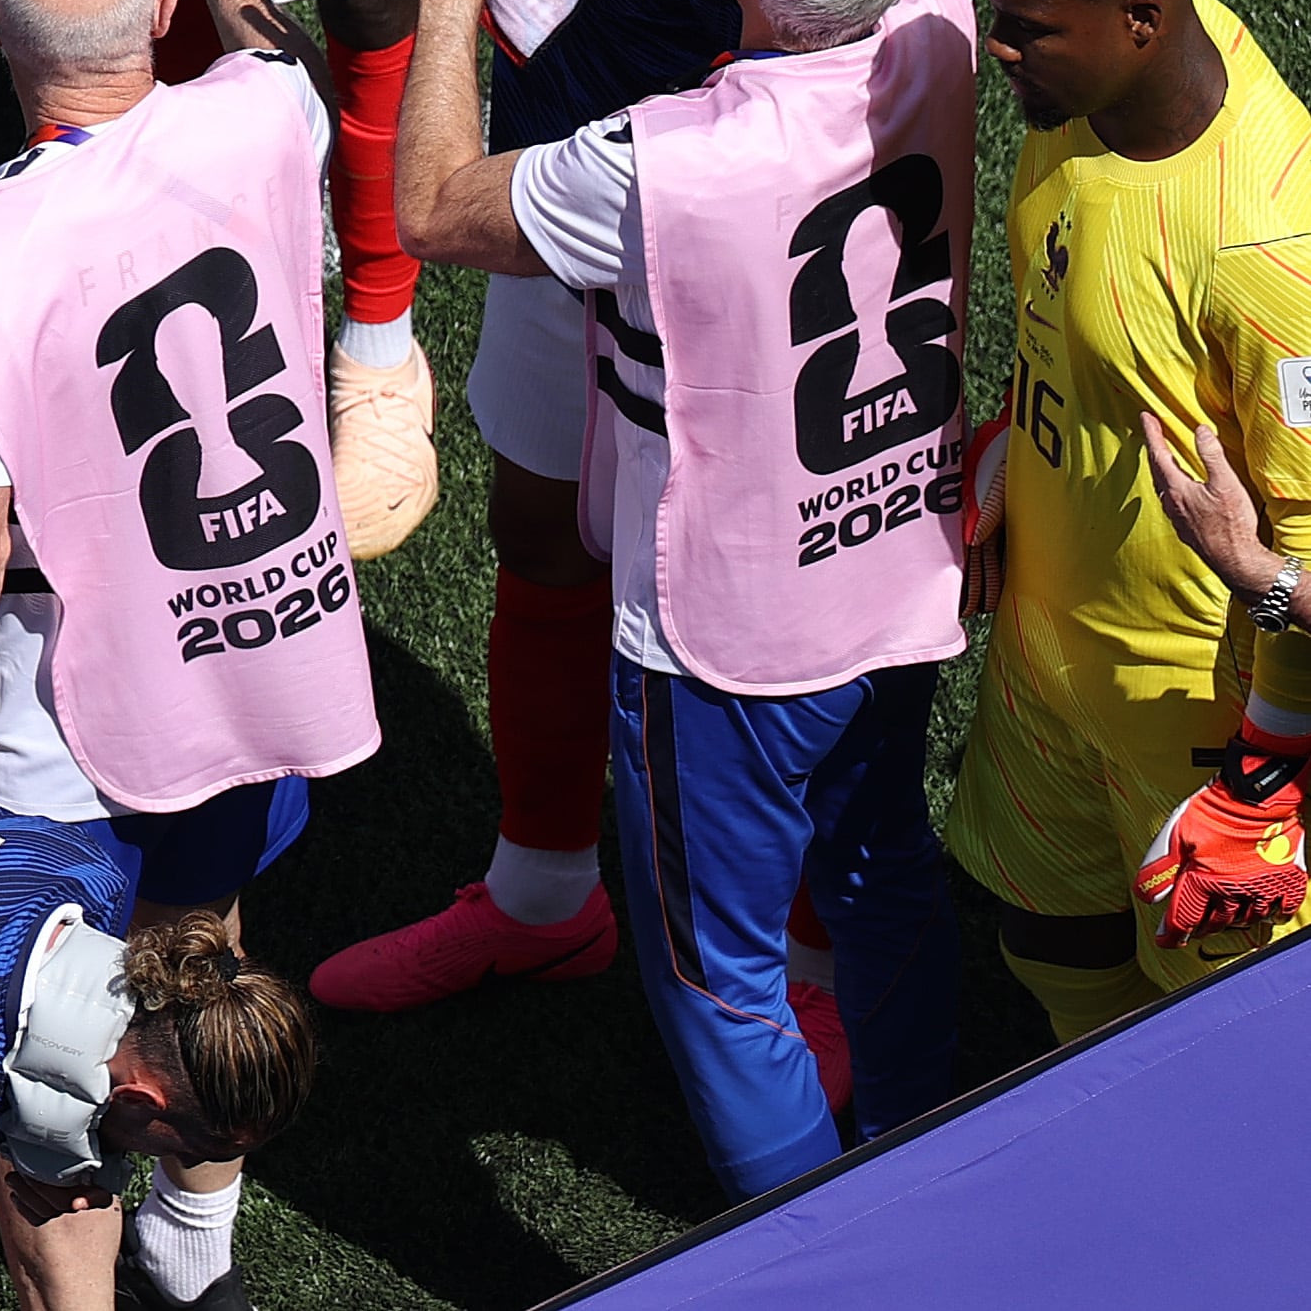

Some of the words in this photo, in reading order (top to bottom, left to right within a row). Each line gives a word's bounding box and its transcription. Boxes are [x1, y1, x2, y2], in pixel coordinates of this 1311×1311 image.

[843, 388, 919, 443] FIFA
[1016, 349, 1064, 469] 16
[198, 488, 288, 543] FIFA
[798, 462, 901, 523] WORLD
[798, 472, 964, 568] 2026
[167, 567, 286, 619] WORLD
[290, 530, 338, 578] CUP
[177, 563, 350, 665] 2026
